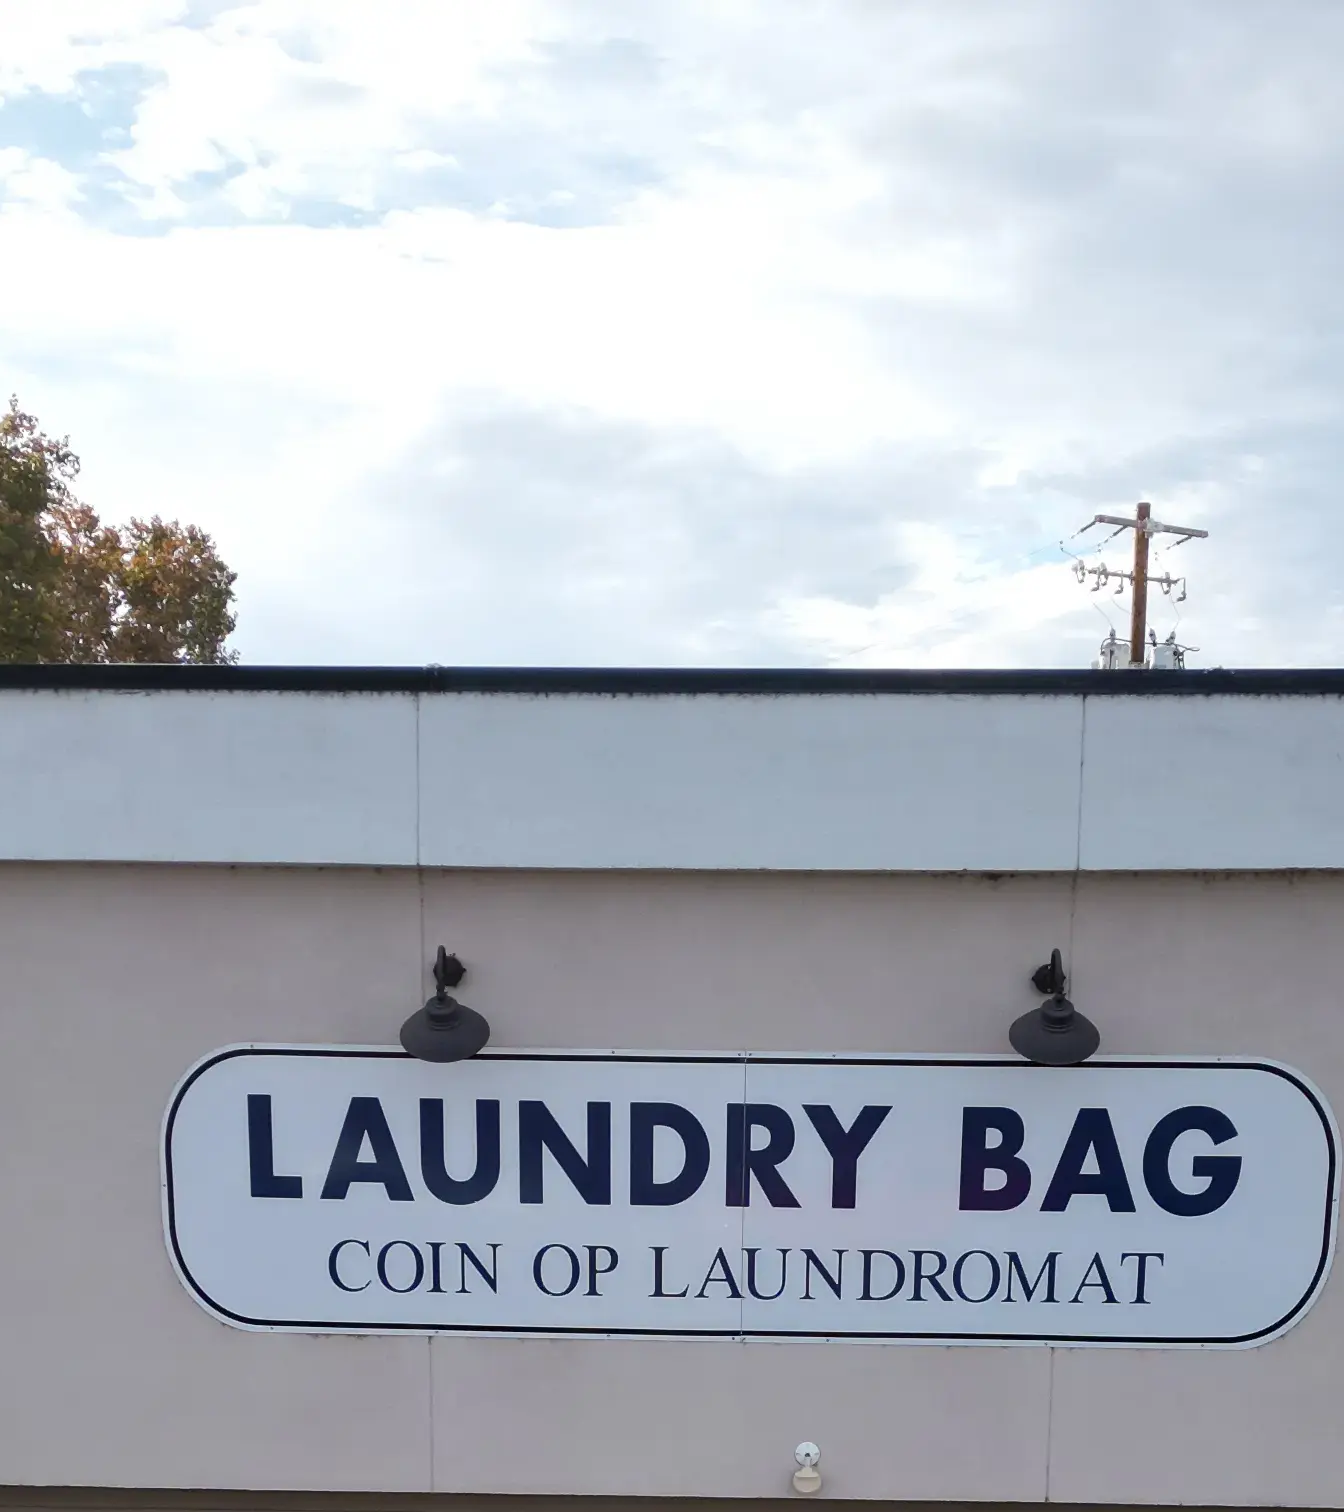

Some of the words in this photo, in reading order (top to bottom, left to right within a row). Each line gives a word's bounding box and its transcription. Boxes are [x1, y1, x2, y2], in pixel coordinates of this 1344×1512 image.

[247, 1093, 893, 1210] LAUNDRY
[959, 1105, 1242, 1217] BAG
[328, 1239, 503, 1295] COIN
[532, 1243, 619, 1297] OP
[648, 1246, 1164, 1304] LAUNDROMAT
